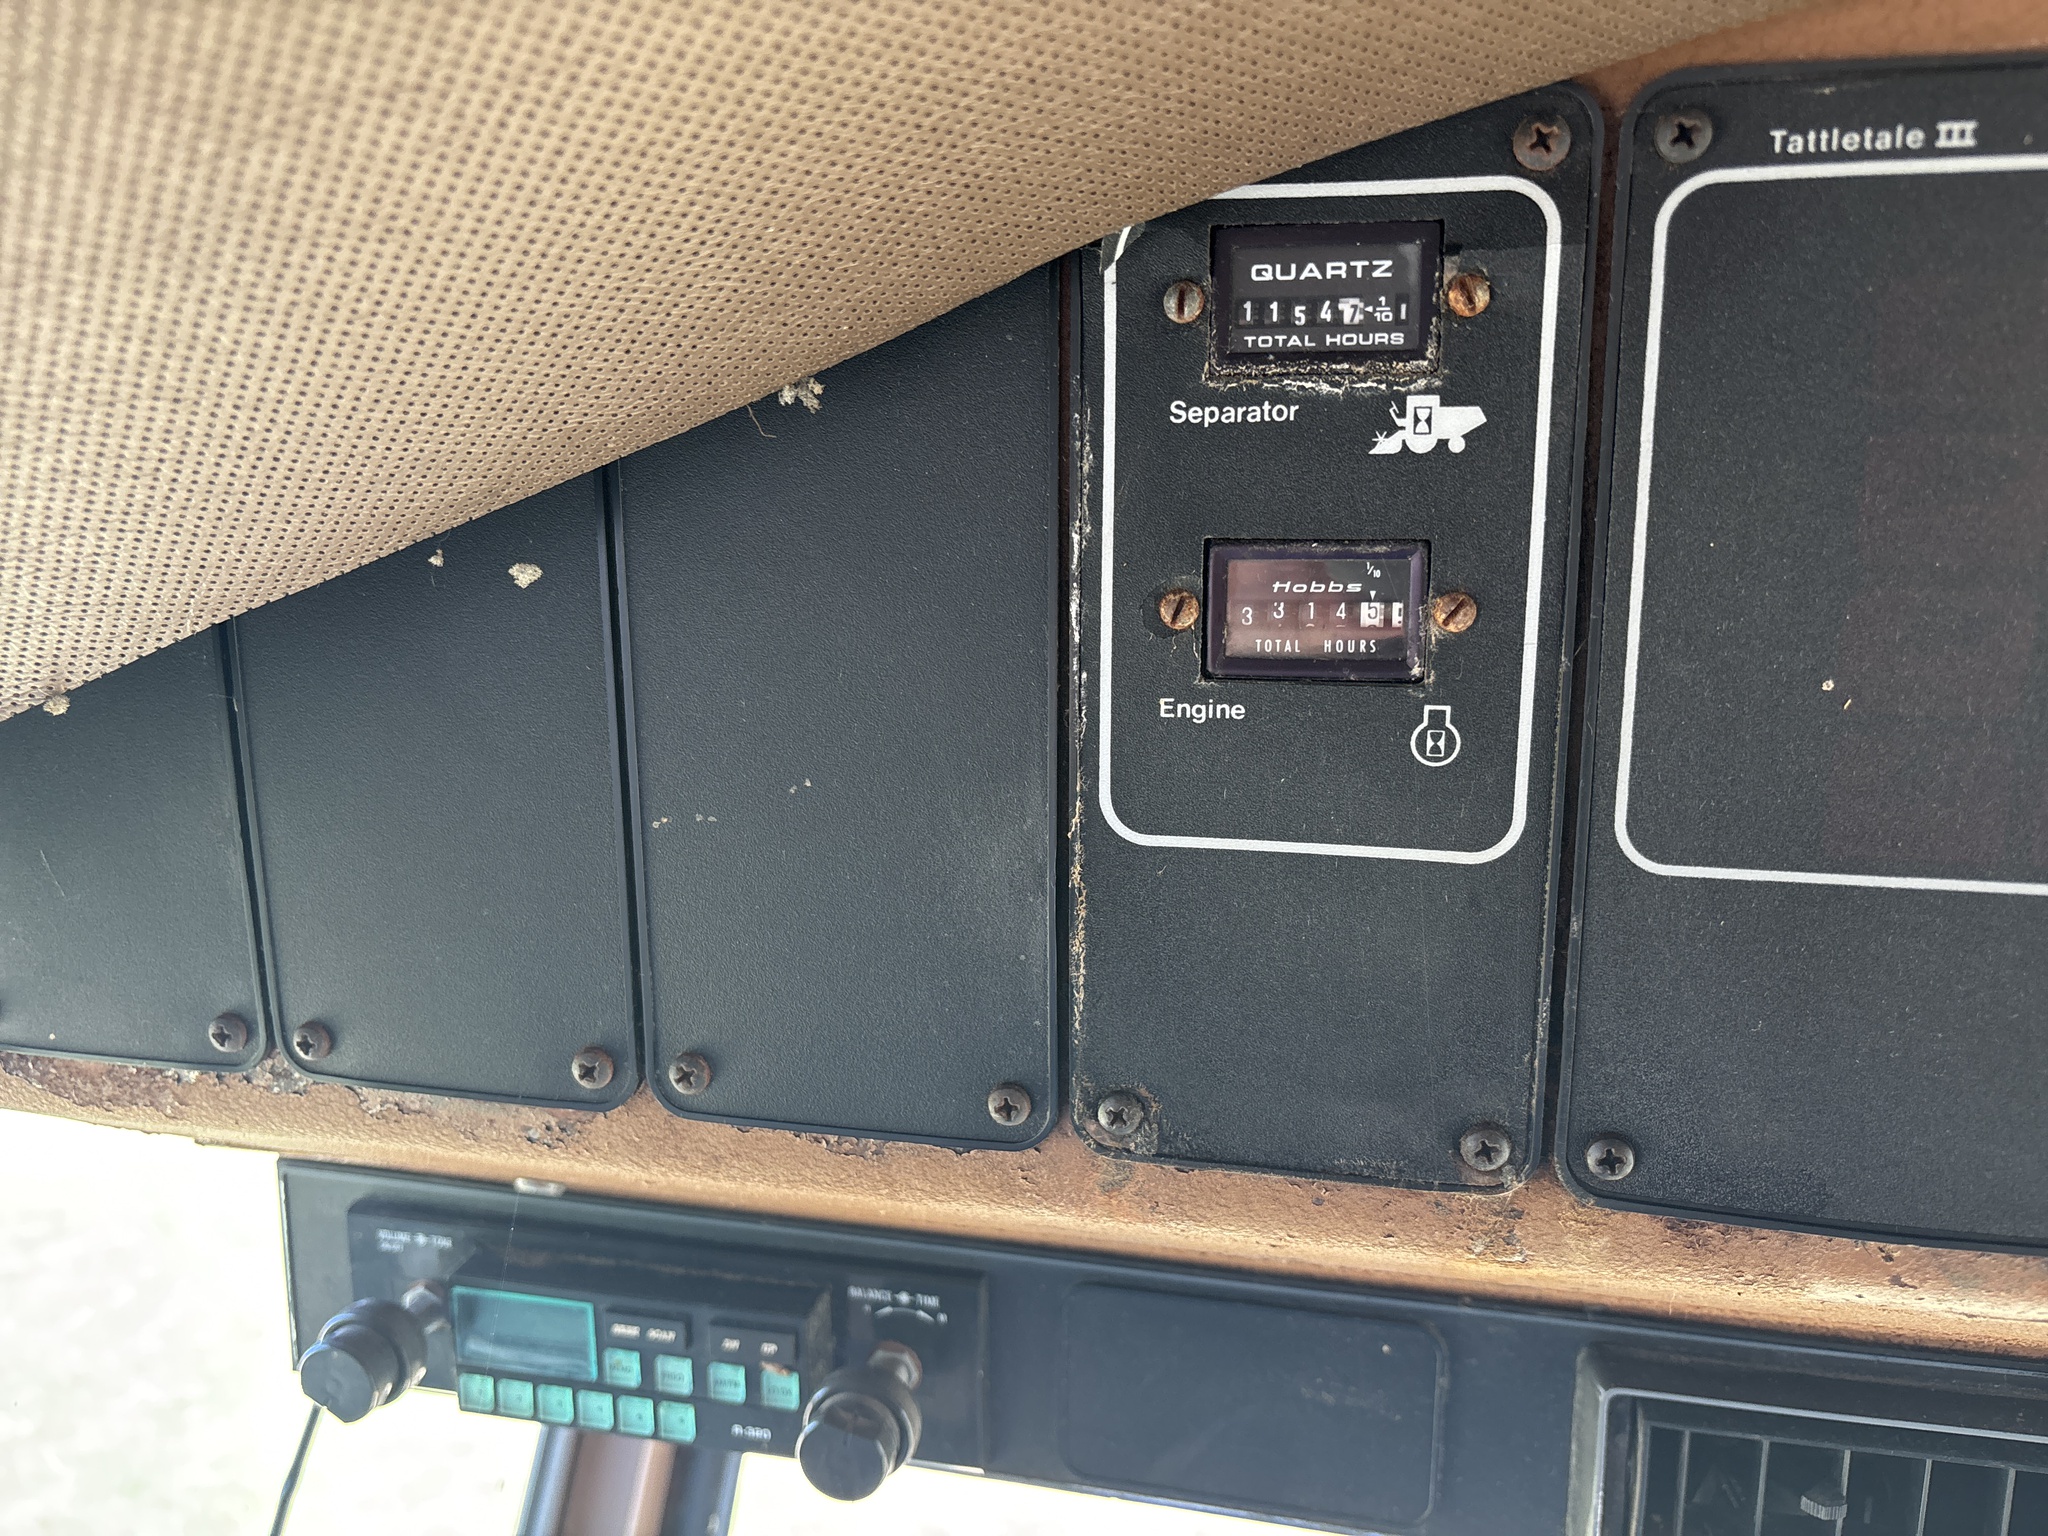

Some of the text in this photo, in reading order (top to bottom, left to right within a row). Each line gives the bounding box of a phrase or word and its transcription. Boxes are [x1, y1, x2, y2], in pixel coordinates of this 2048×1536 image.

[1769, 119, 1979, 154] Tattletale III
[1250, 259, 1394, 282] QUARTZ
[1243, 332, 1405, 349] TOTAL HOURS
[1169, 399, 1300, 428] Separator
[1271, 580, 1363, 594] Hobbs
[1255, 639, 1377, 654] TOTAL HOURS
[1158, 697, 1246, 724] Engine
